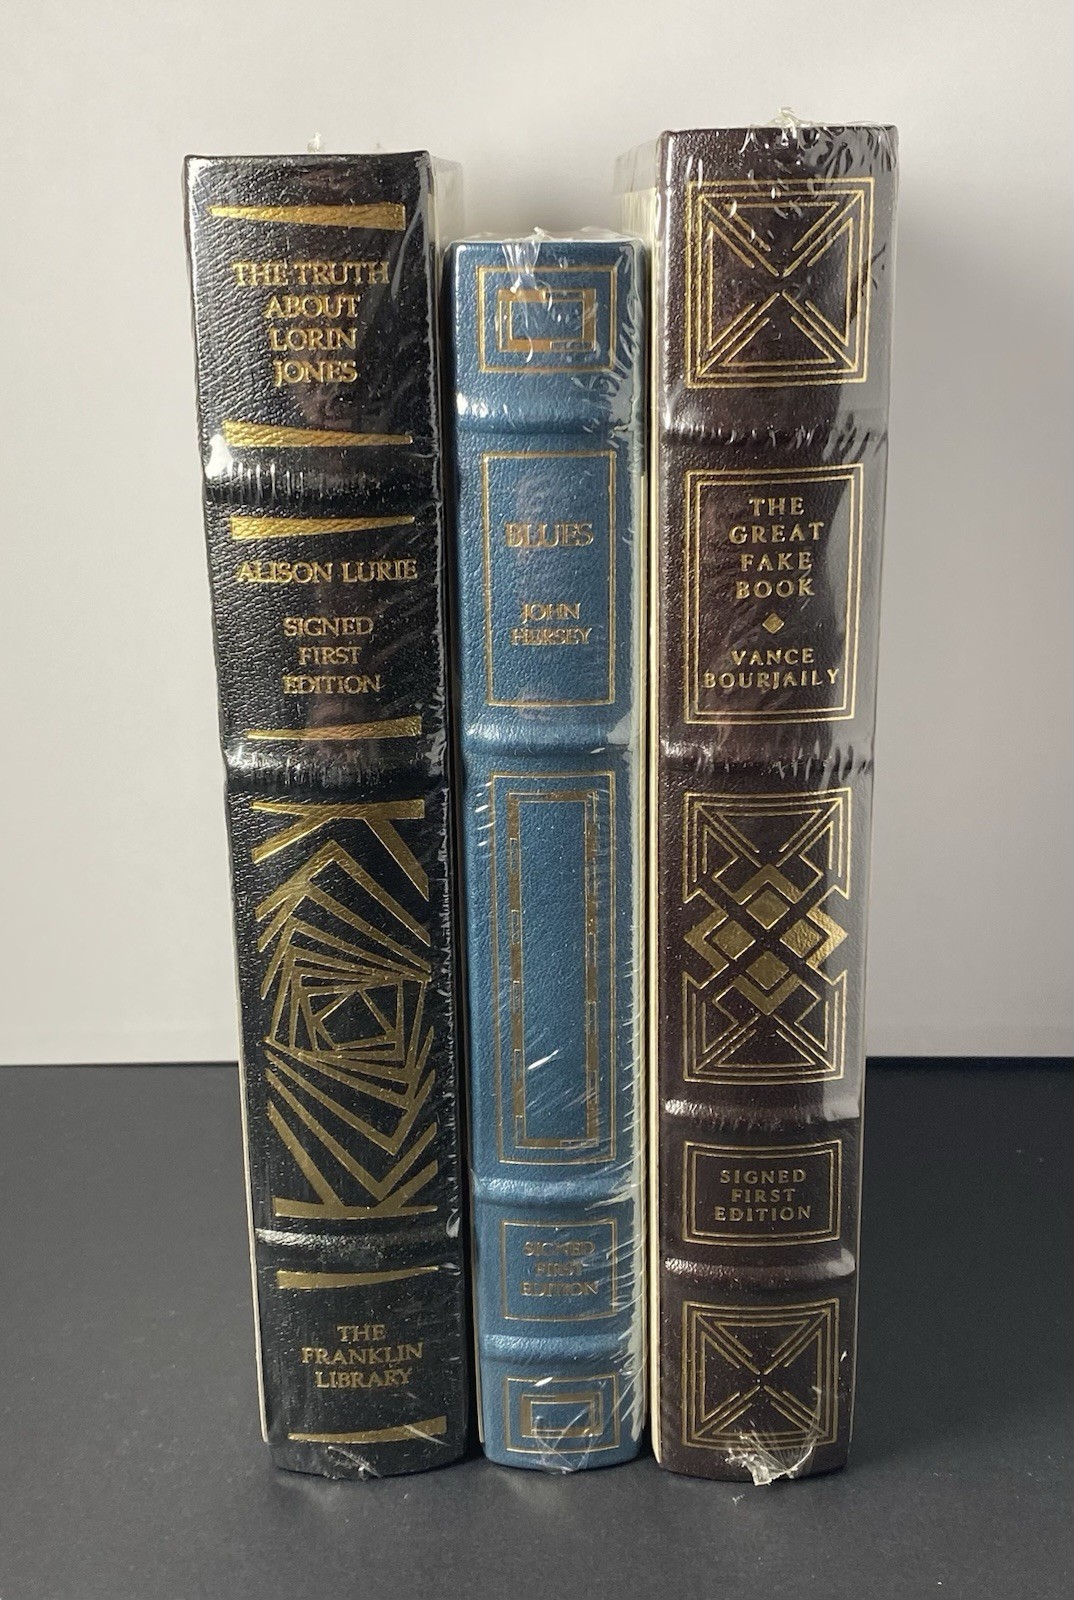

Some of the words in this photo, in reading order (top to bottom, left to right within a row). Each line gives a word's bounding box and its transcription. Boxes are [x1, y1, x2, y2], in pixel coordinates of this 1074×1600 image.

[231, 261, 289, 287] THE
[293, 261, 390, 286] TRUTH
[264, 293, 361, 319] ABOUT
[268, 327, 358, 352] LORIN
[272, 358, 358, 388] JONES
[748, 497, 805, 517] THE
[504, 521, 594, 548] BLUES
[728, 521, 825, 544] GREAT
[235, 560, 334, 584] ALISON
[341, 558, 419, 583] LURIE
[739, 551, 814, 572] FAKE
[735, 578, 815, 600] BOOK
[521, 602, 581, 624] JOHN
[283, 616, 374, 638] SIGNED
[510, 627, 592, 646] HERSEY
[299, 646, 362, 666] FIRST
[730, 647, 814, 666] VANCE
[280, 673, 382, 695] EDITION
[701, 667, 840, 690] BOURJAILY
[720, 1169, 807, 1184] SIGNED
[731, 1188, 796, 1203] FIRST
[714, 1205, 811, 1222] EDITION
[534, 1261, 583, 1277] FIRST
[521, 1281, 598, 1297] EDITION
[337, 1324, 386, 1342] THE
[301, 1341, 425, 1365] FRANKLIN
[315, 1368, 413, 1389] LIBRARY
